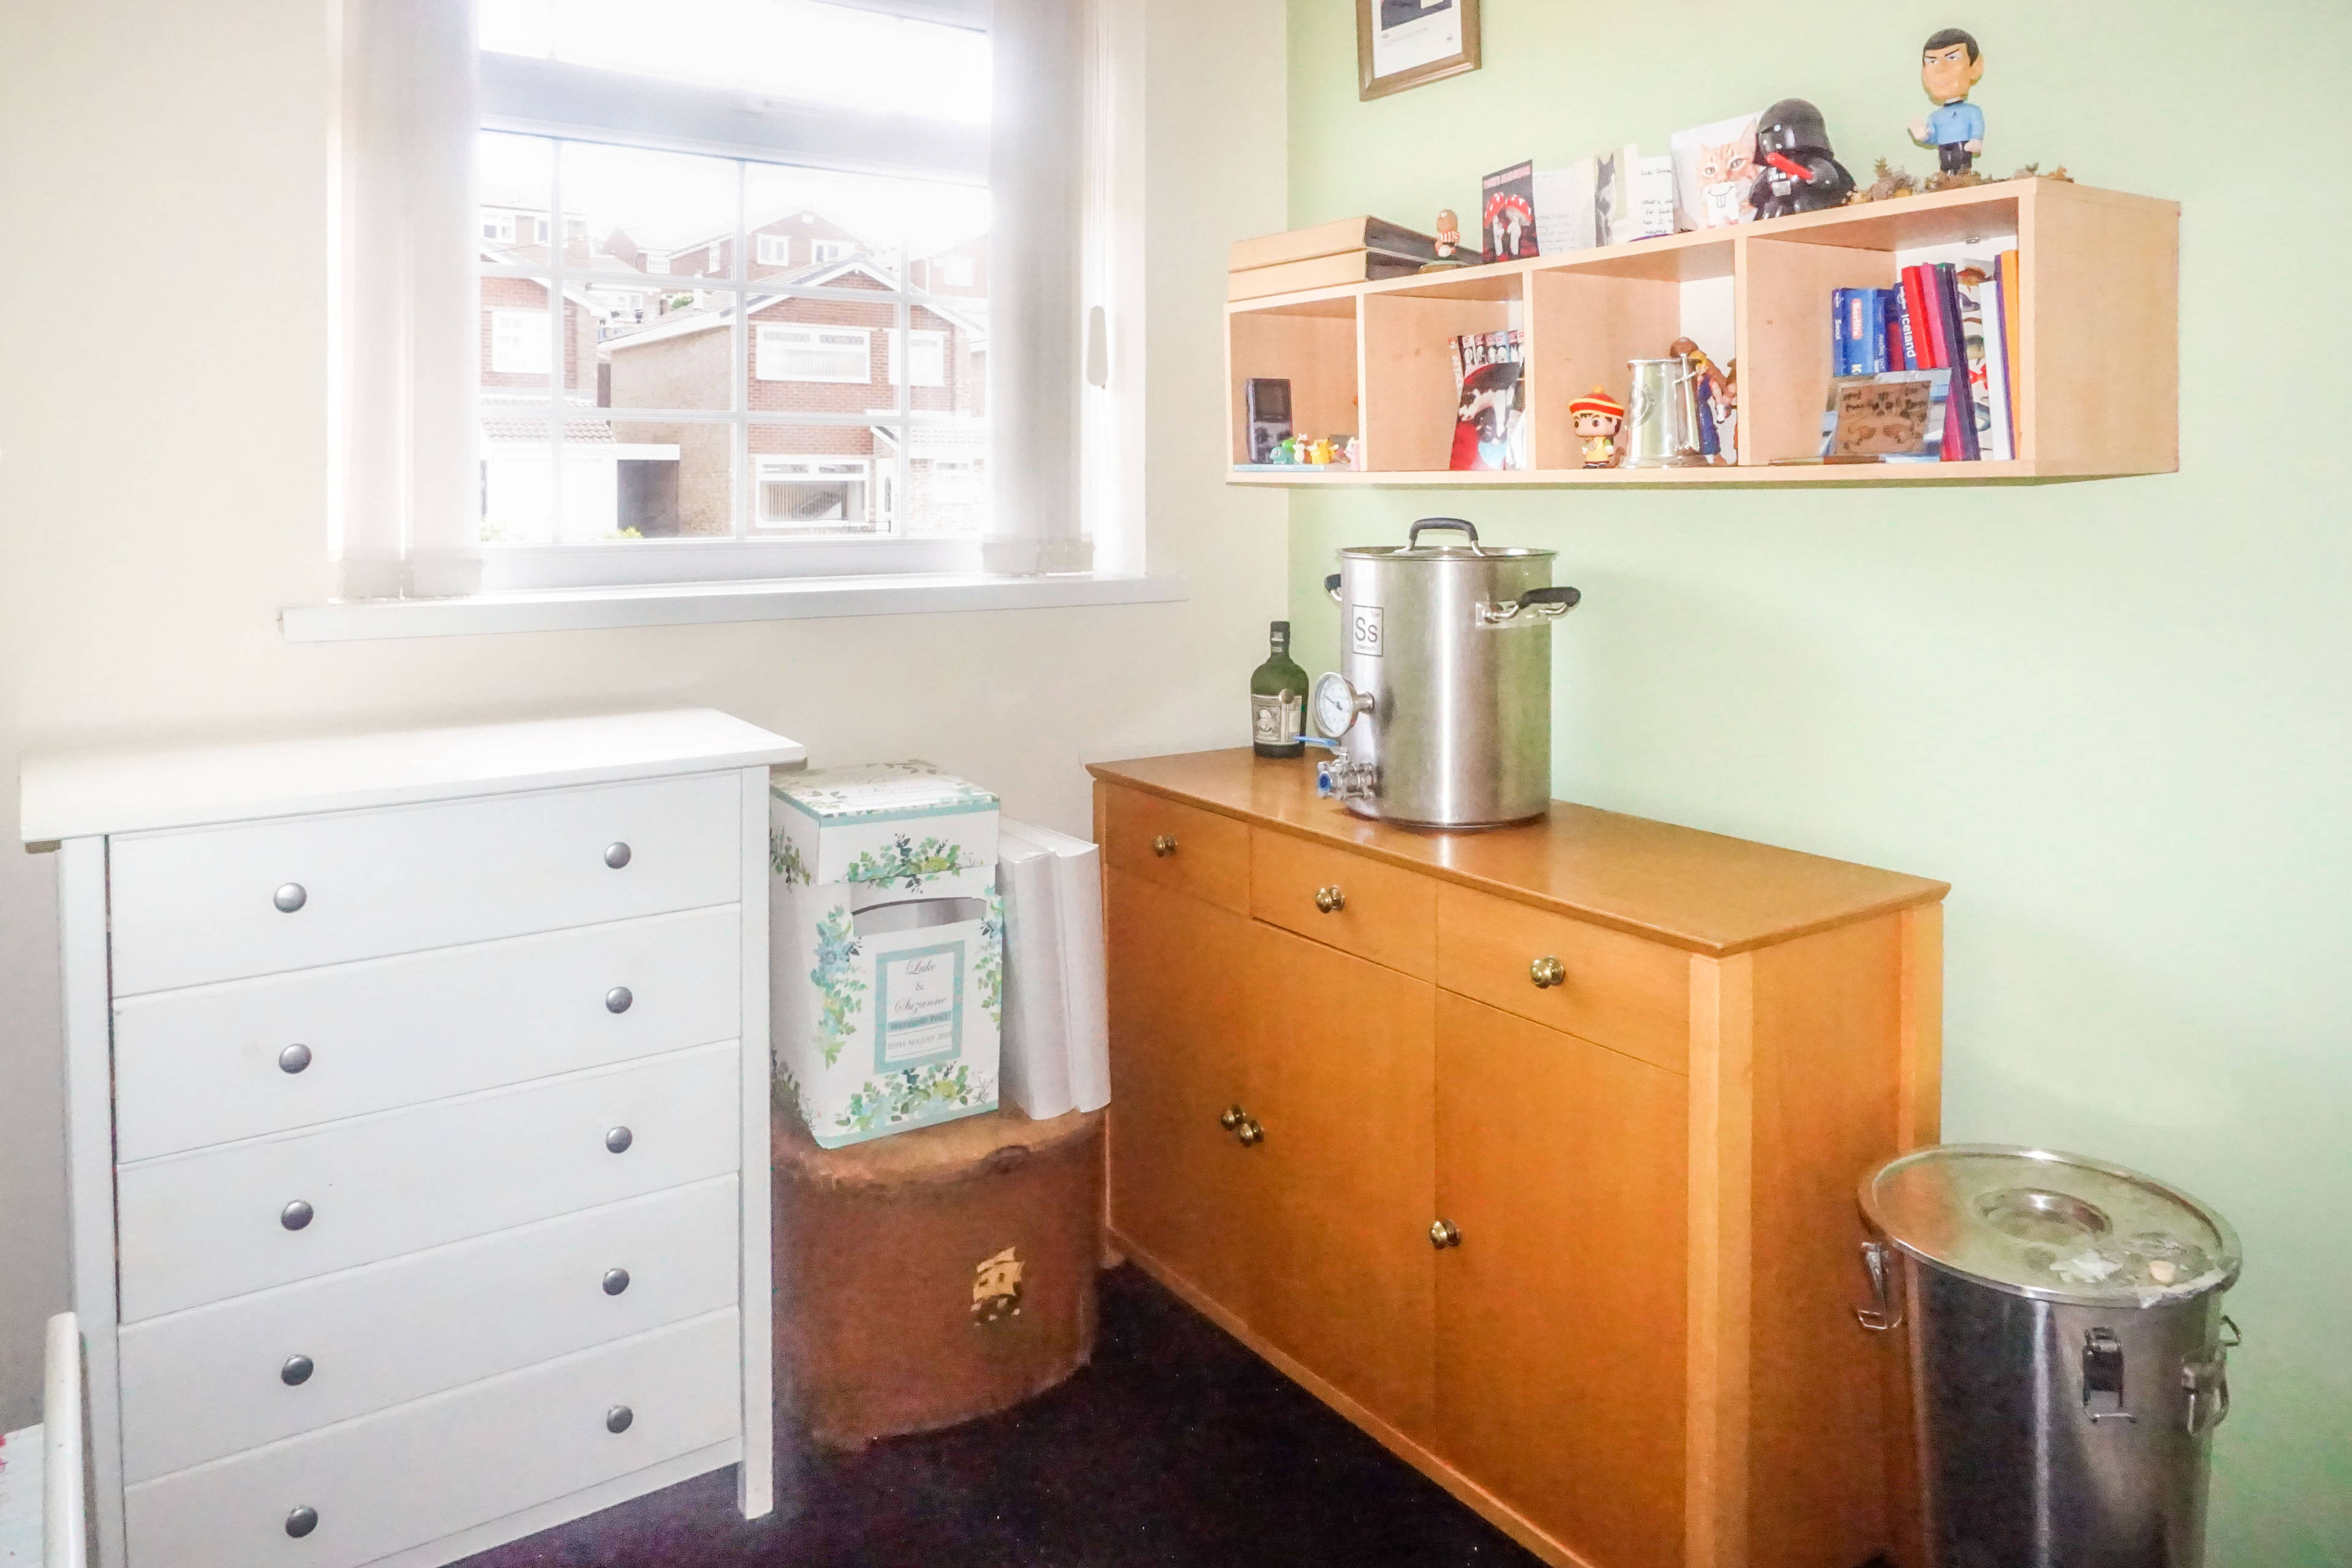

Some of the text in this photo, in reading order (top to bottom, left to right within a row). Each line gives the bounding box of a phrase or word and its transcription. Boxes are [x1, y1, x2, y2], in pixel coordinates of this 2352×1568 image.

[1901, 314, 1917, 358] Iceland
[1355, 616, 1378, 643] Ss
[906, 959, 937, 974] Luke
[916, 981, 924, 990] &
[894, 997, 946, 1014] Suzanne
[908, 1035, 935, 1046] AUGUST
